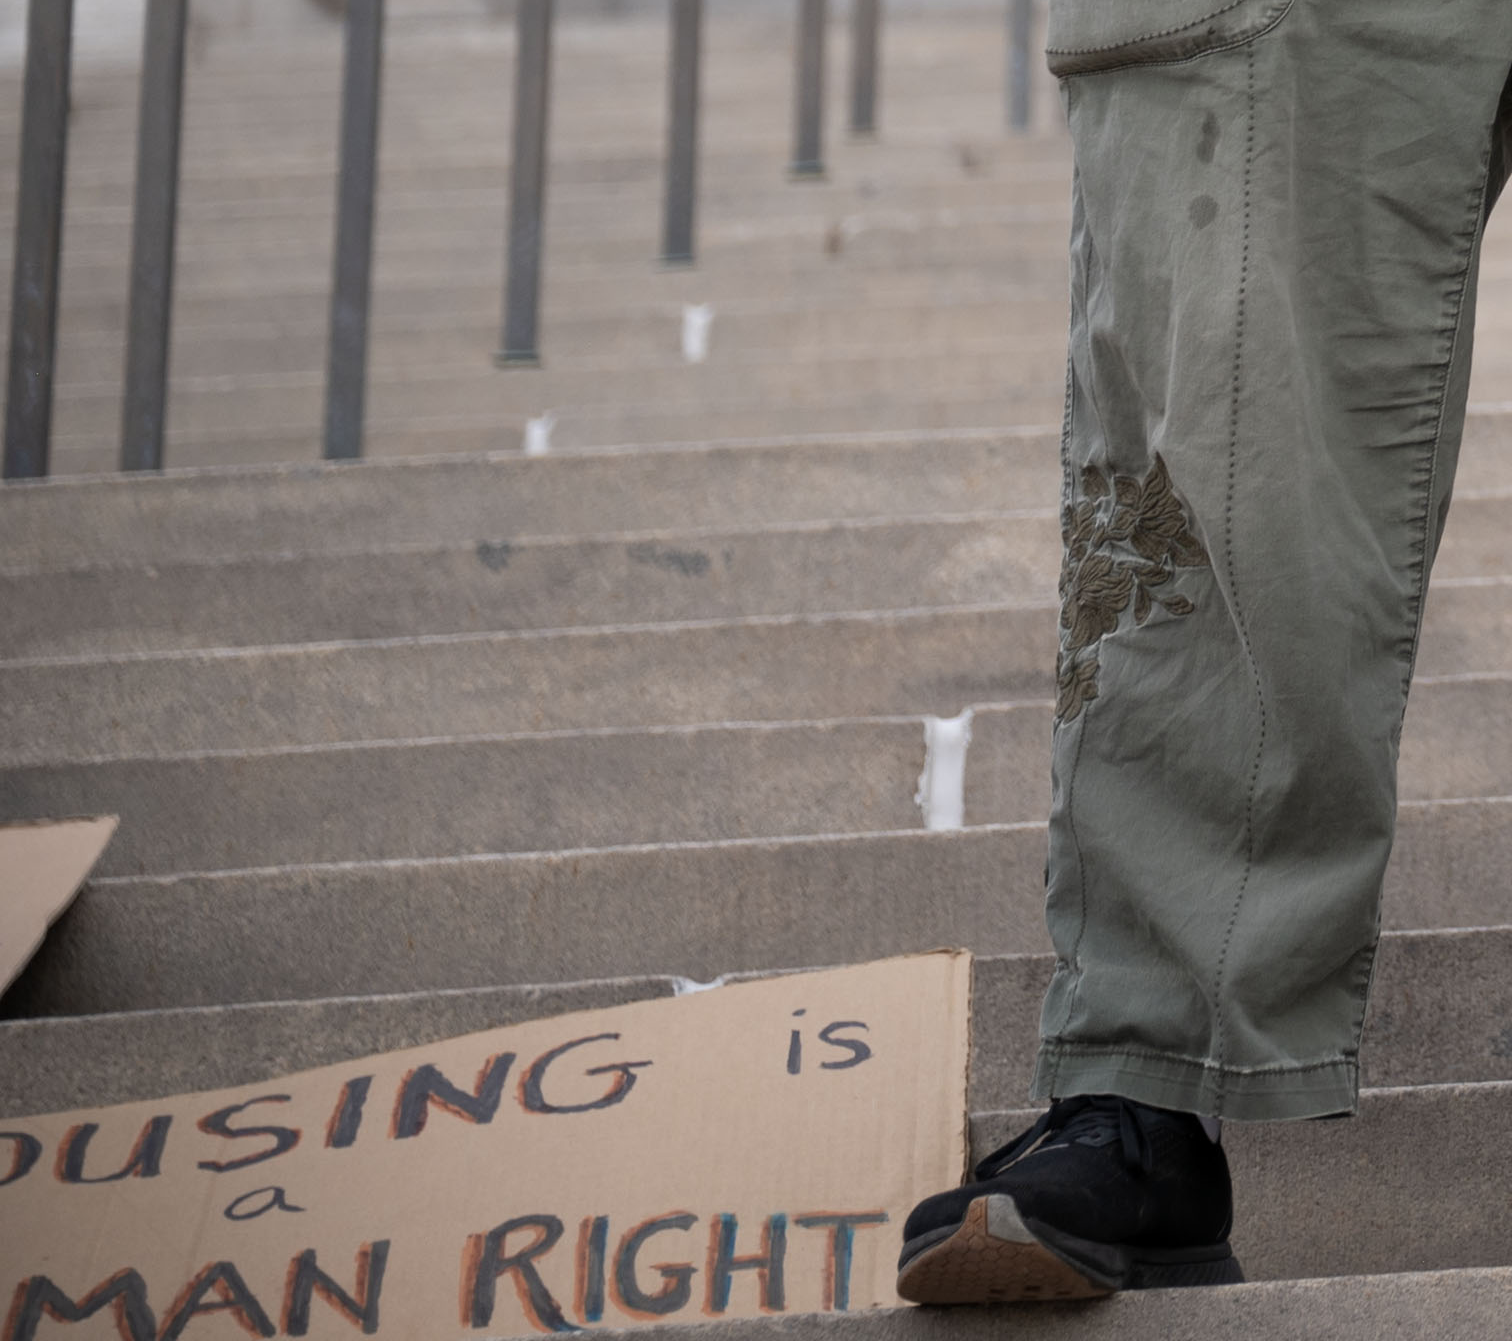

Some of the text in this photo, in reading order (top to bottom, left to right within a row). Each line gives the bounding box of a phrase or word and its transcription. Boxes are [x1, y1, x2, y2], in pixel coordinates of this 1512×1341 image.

[785, 1008, 872, 1074] is
[224, 1186, 306, 1221] a
[461, 1209, 890, 1331] RIGHT
